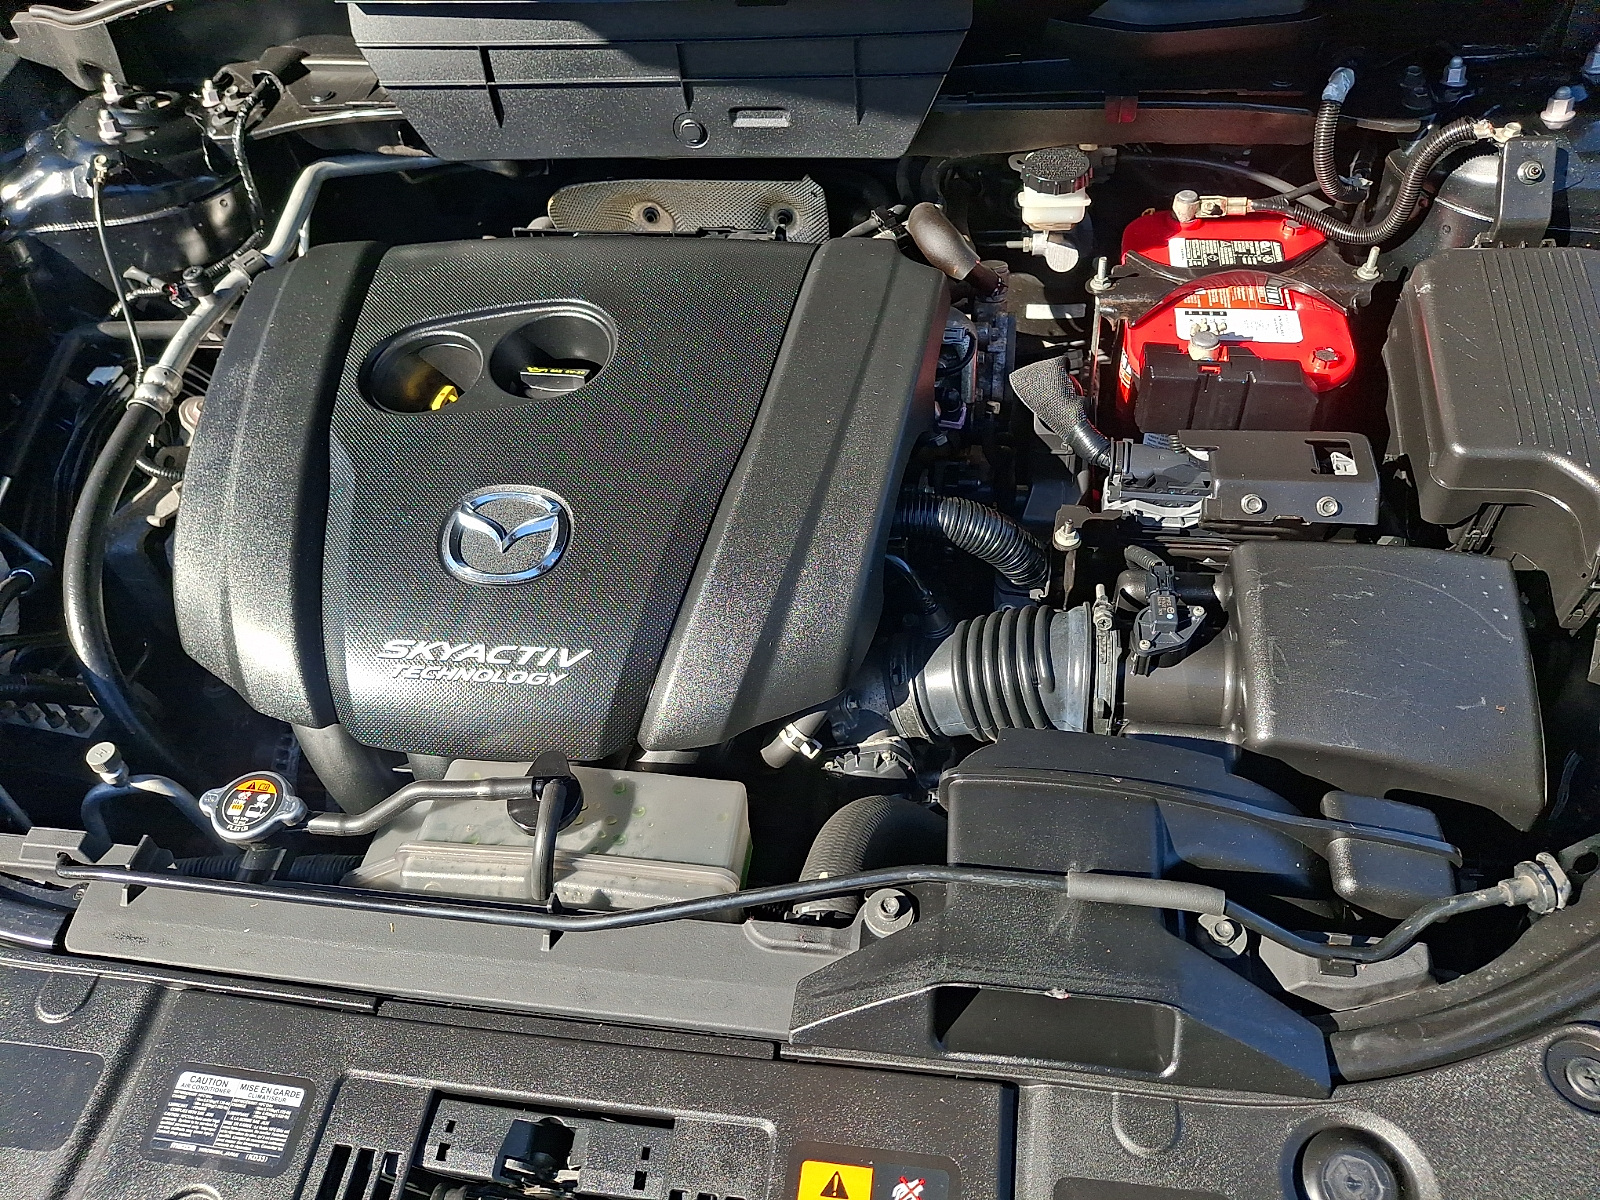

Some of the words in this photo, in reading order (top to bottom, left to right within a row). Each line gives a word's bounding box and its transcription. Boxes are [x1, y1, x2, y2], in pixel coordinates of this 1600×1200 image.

[377, 639, 593, 668] SKYACTIV
[392, 665, 572, 687] TECHNOLOGY
[189, 1075, 229, 1088] CAUTION
[191, 1084, 232, 1095] CONDITIONER
[240, 1083, 260, 1093] MISE
[260, 1086, 274, 1095] EN
[273, 1087, 301, 1099] GARDE
[247, 1092, 287, 1103] CLIMATISEUR
